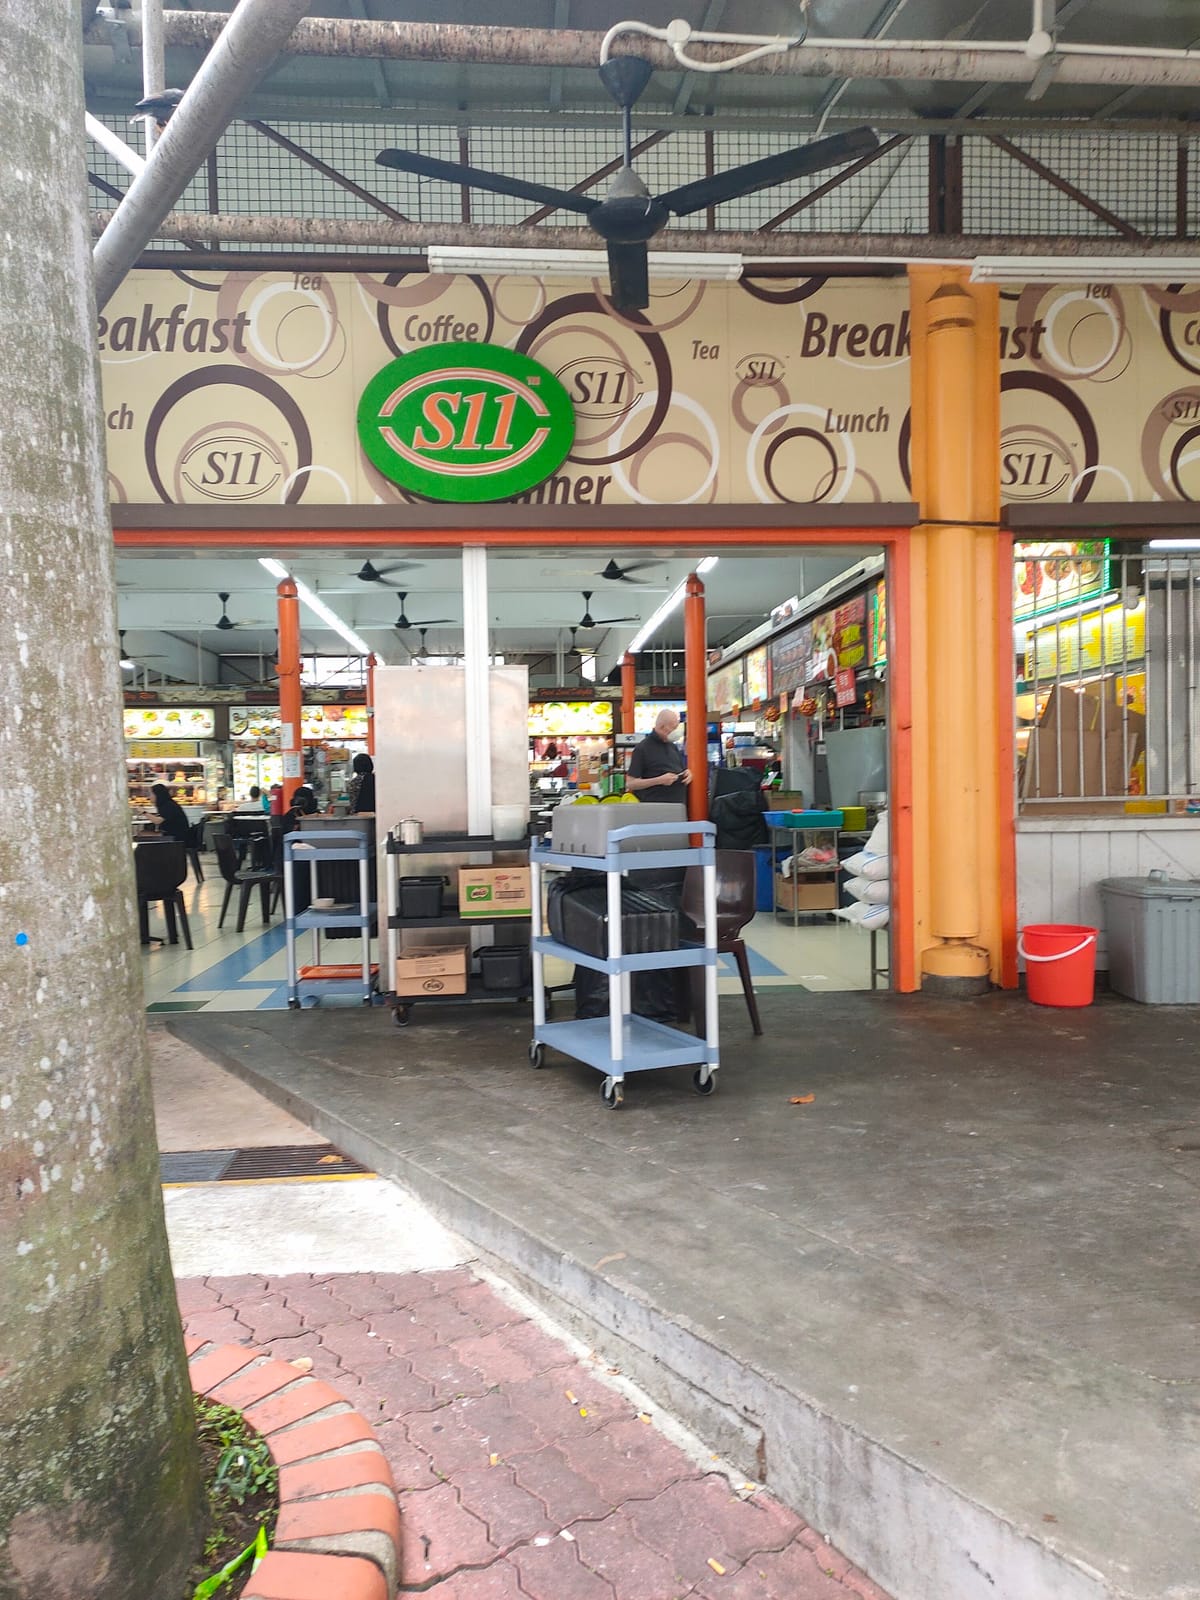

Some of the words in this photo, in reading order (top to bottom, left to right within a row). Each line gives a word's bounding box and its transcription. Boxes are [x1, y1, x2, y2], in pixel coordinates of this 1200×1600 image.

[292, 271, 322, 291] Tea
[97, 303, 251, 354] eakfast
[403, 314, 480, 343] Coffee
[691, 340, 721, 360] Tea
[744, 361, 777, 380] S11
[570, 371, 627, 404] S11
[411, 391, 518, 451] S11
[824, 406, 890, 434] Lunch
[201, 451, 262, 486] S11
[1000, 453, 1053, 485] S11
